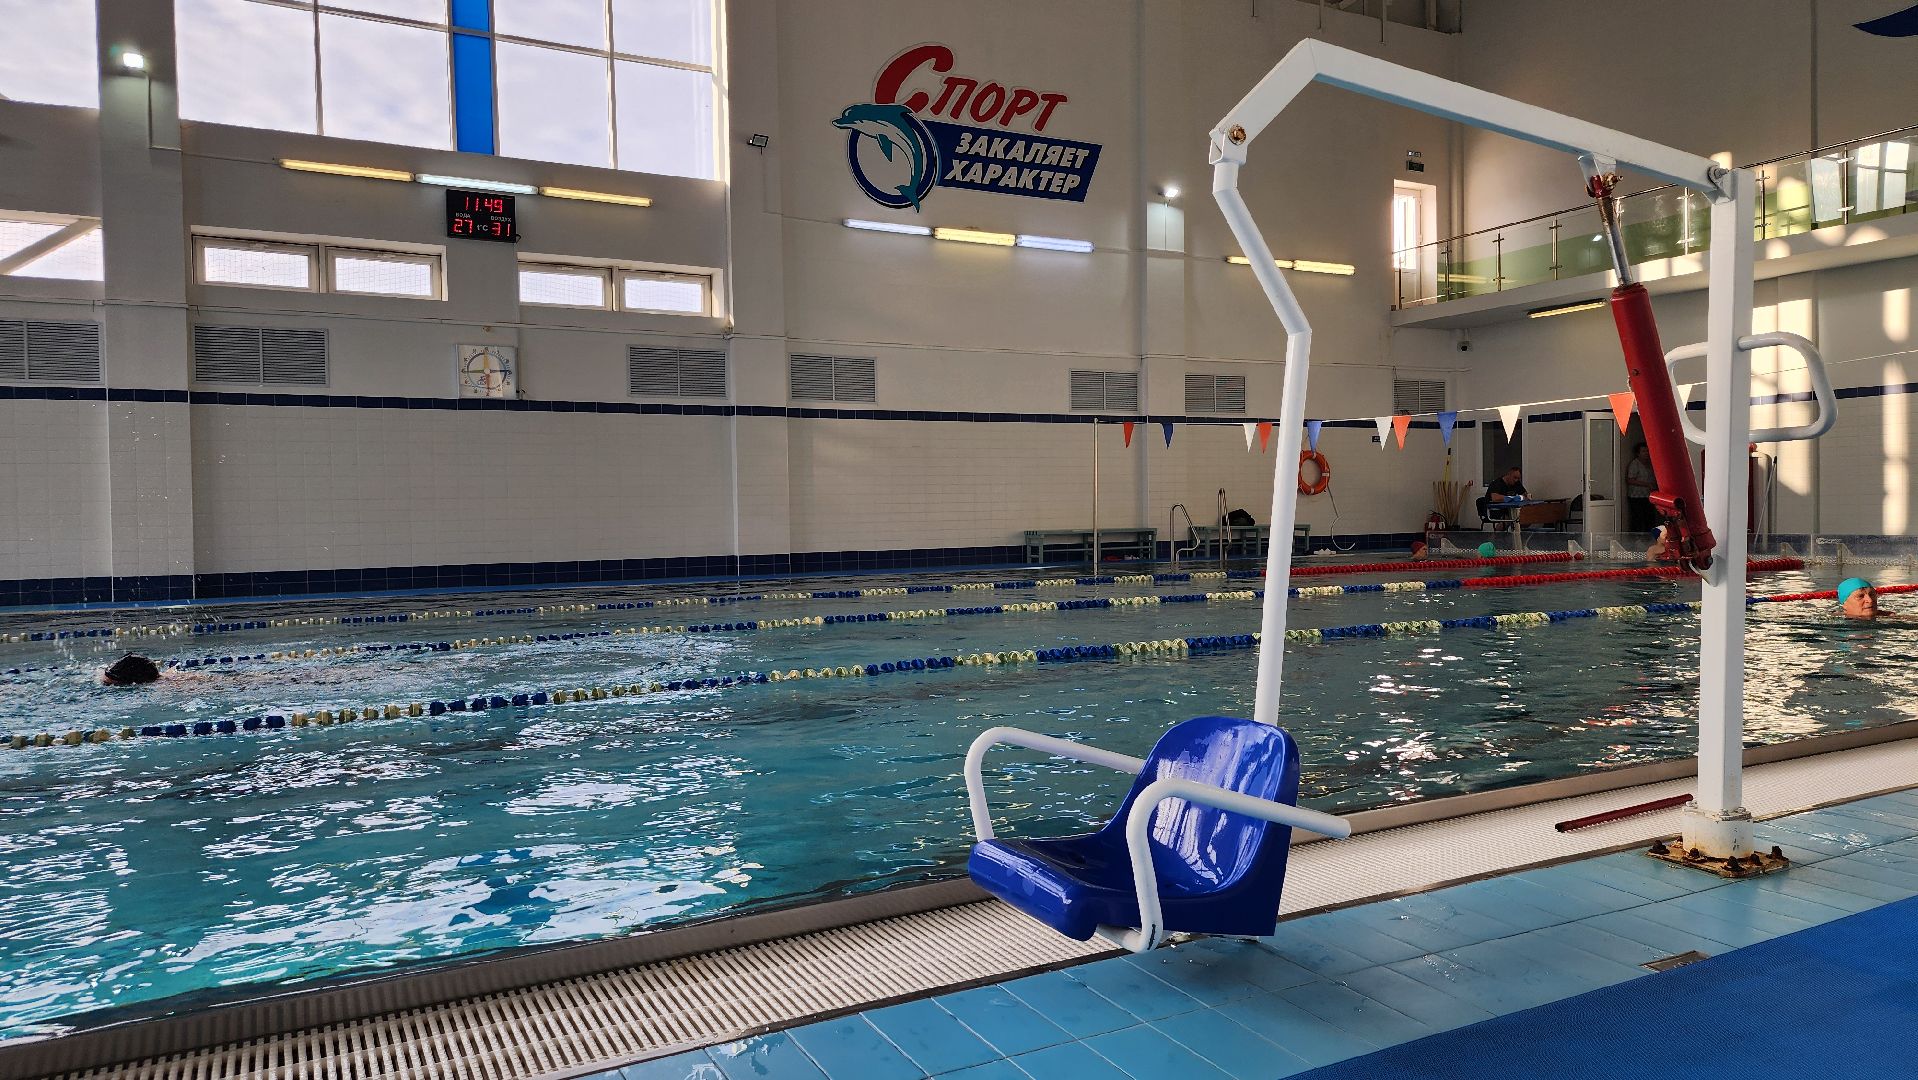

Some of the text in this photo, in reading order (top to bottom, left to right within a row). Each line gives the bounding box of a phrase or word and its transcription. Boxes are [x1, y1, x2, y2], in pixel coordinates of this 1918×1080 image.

[875, 45, 1068, 132] СПОРТ
[954, 133, 1090, 169] ЗАКАЛЯЕТ
[944, 160, 1081, 194] ХАРАКТЕР
[453, 218, 473, 234] 27
[491, 222, 511, 237] 31
